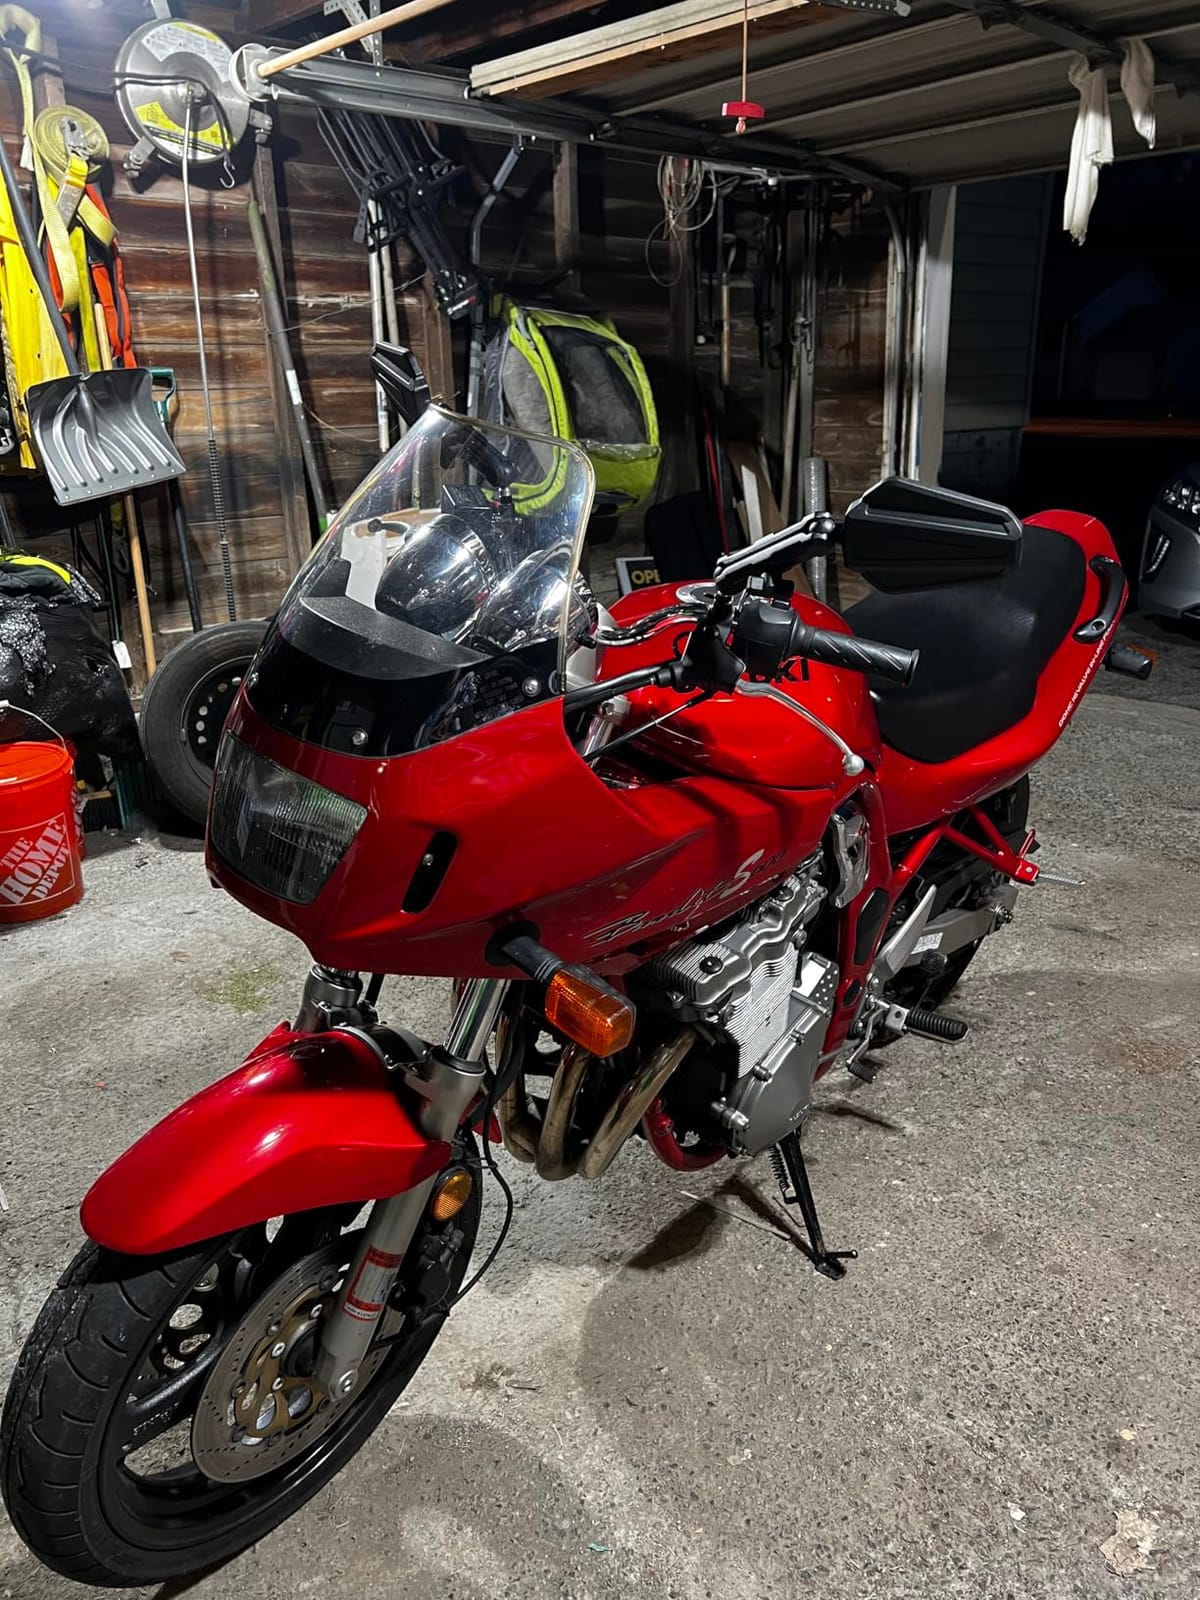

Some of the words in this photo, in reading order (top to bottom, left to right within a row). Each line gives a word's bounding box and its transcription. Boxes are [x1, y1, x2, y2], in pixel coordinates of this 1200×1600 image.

[631, 569, 661, 584] OPE
[0, 836, 34, 870] THE
[0, 820, 66, 904] HOME
[31, 842, 70, 899] DEPOT
